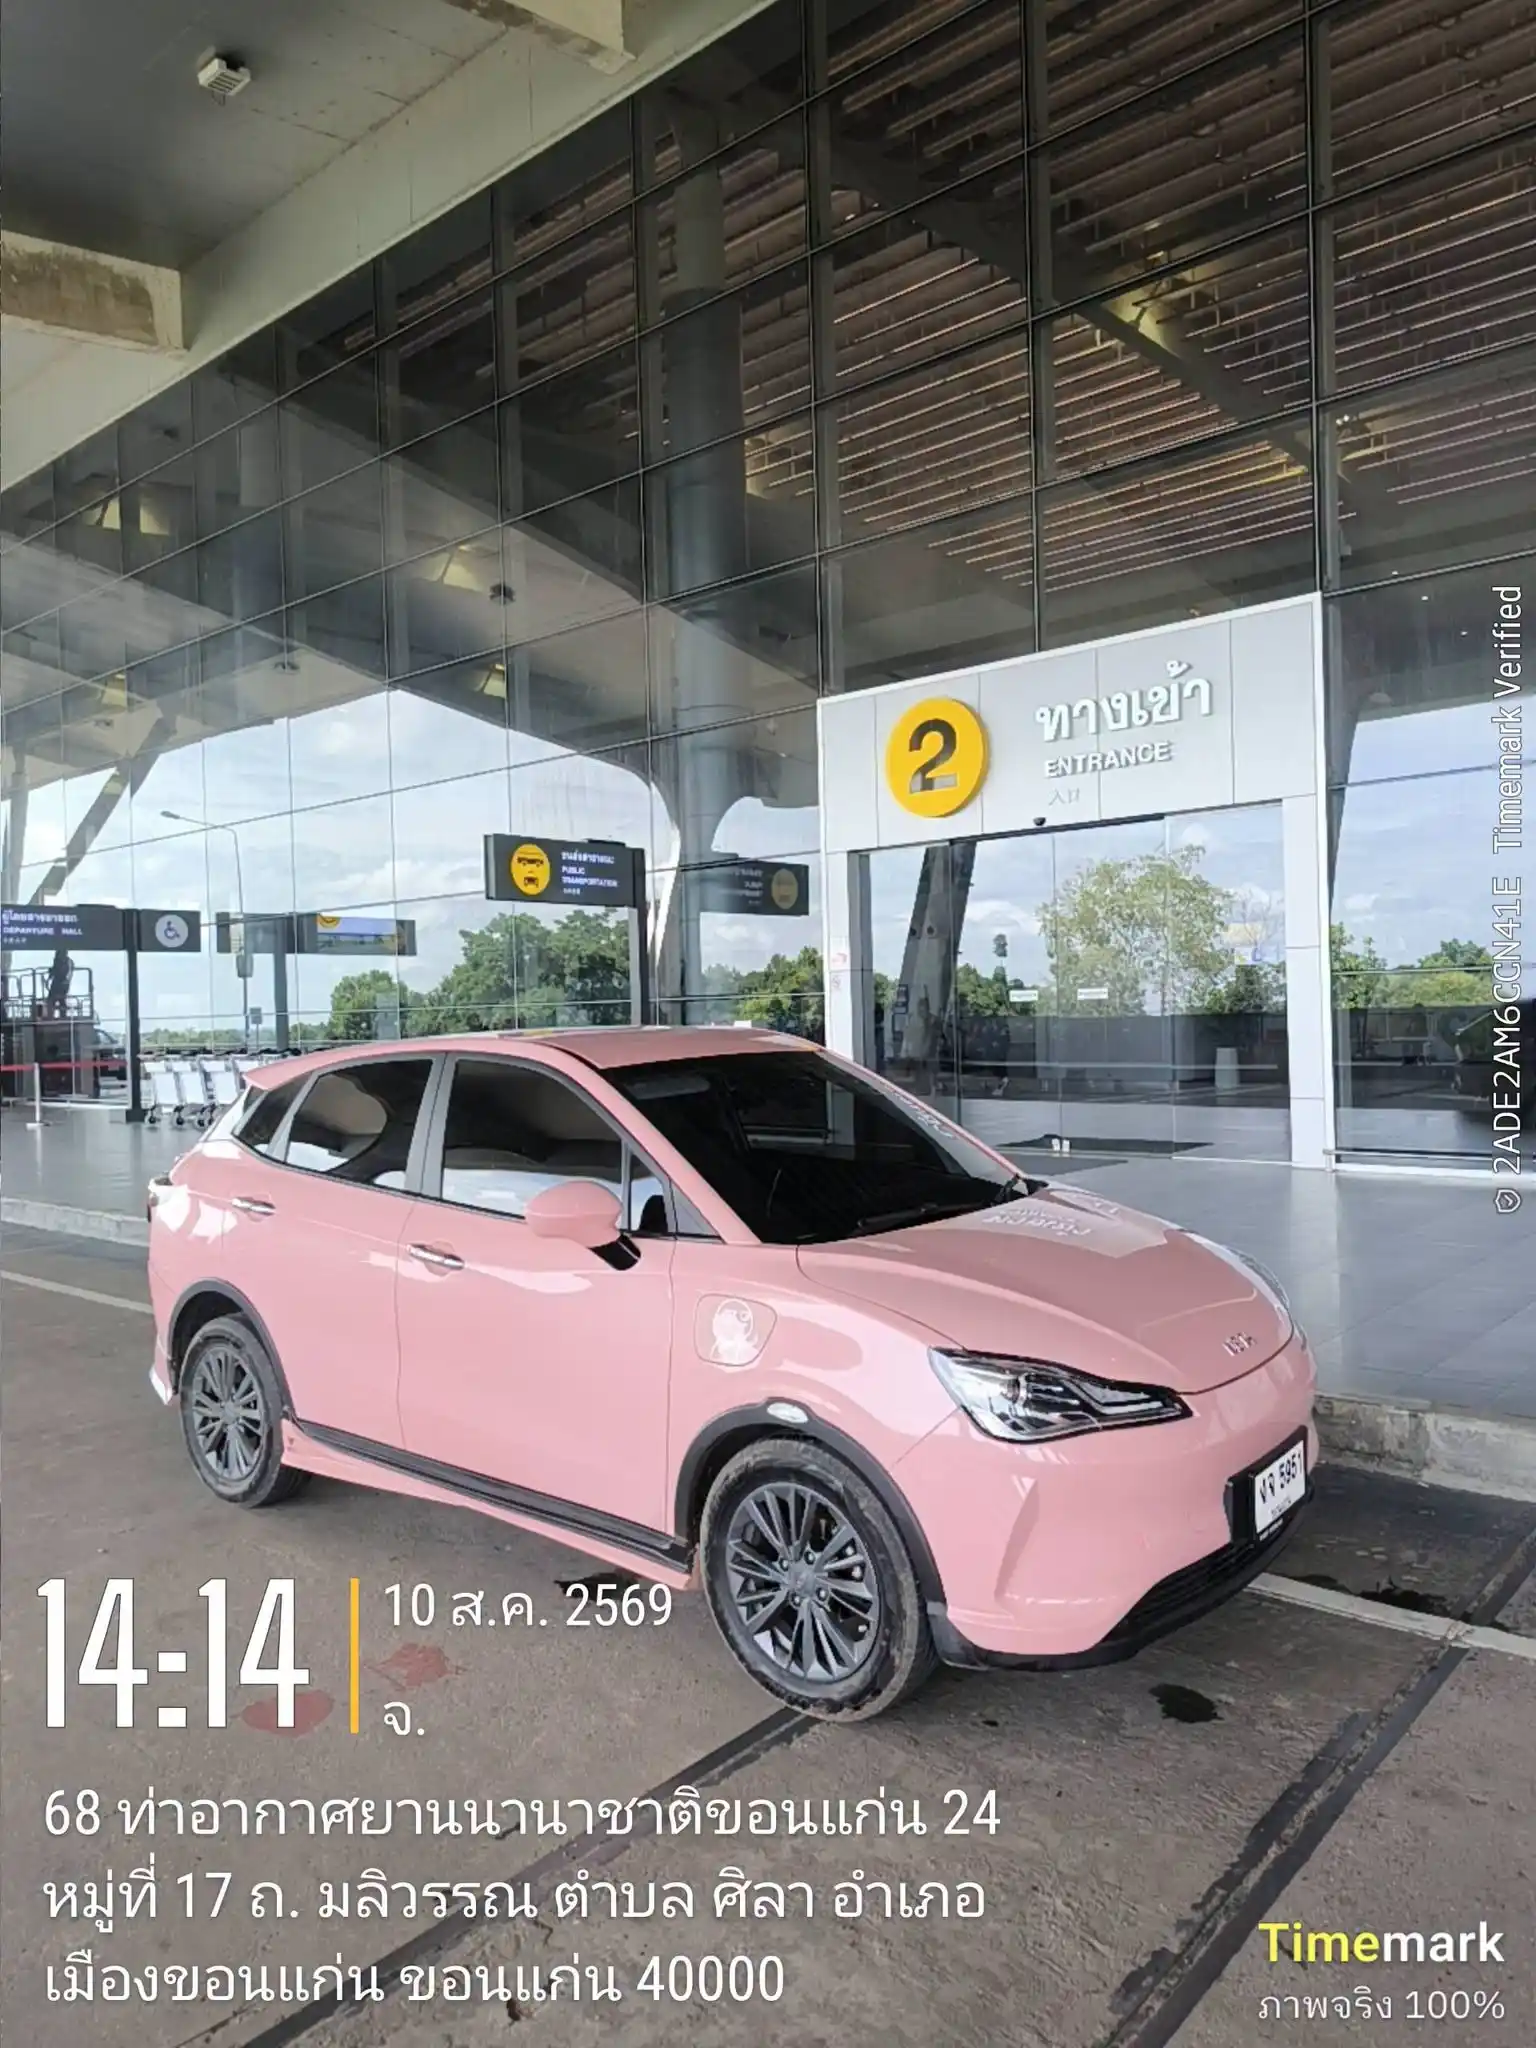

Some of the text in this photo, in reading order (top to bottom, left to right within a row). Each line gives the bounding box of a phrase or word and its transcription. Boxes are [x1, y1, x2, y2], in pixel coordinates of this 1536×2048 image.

[1035, 659, 1213, 743] ทางเข้า
[908, 717, 958, 795] 2
[1044, 739, 1174, 778] ENTRANCE
